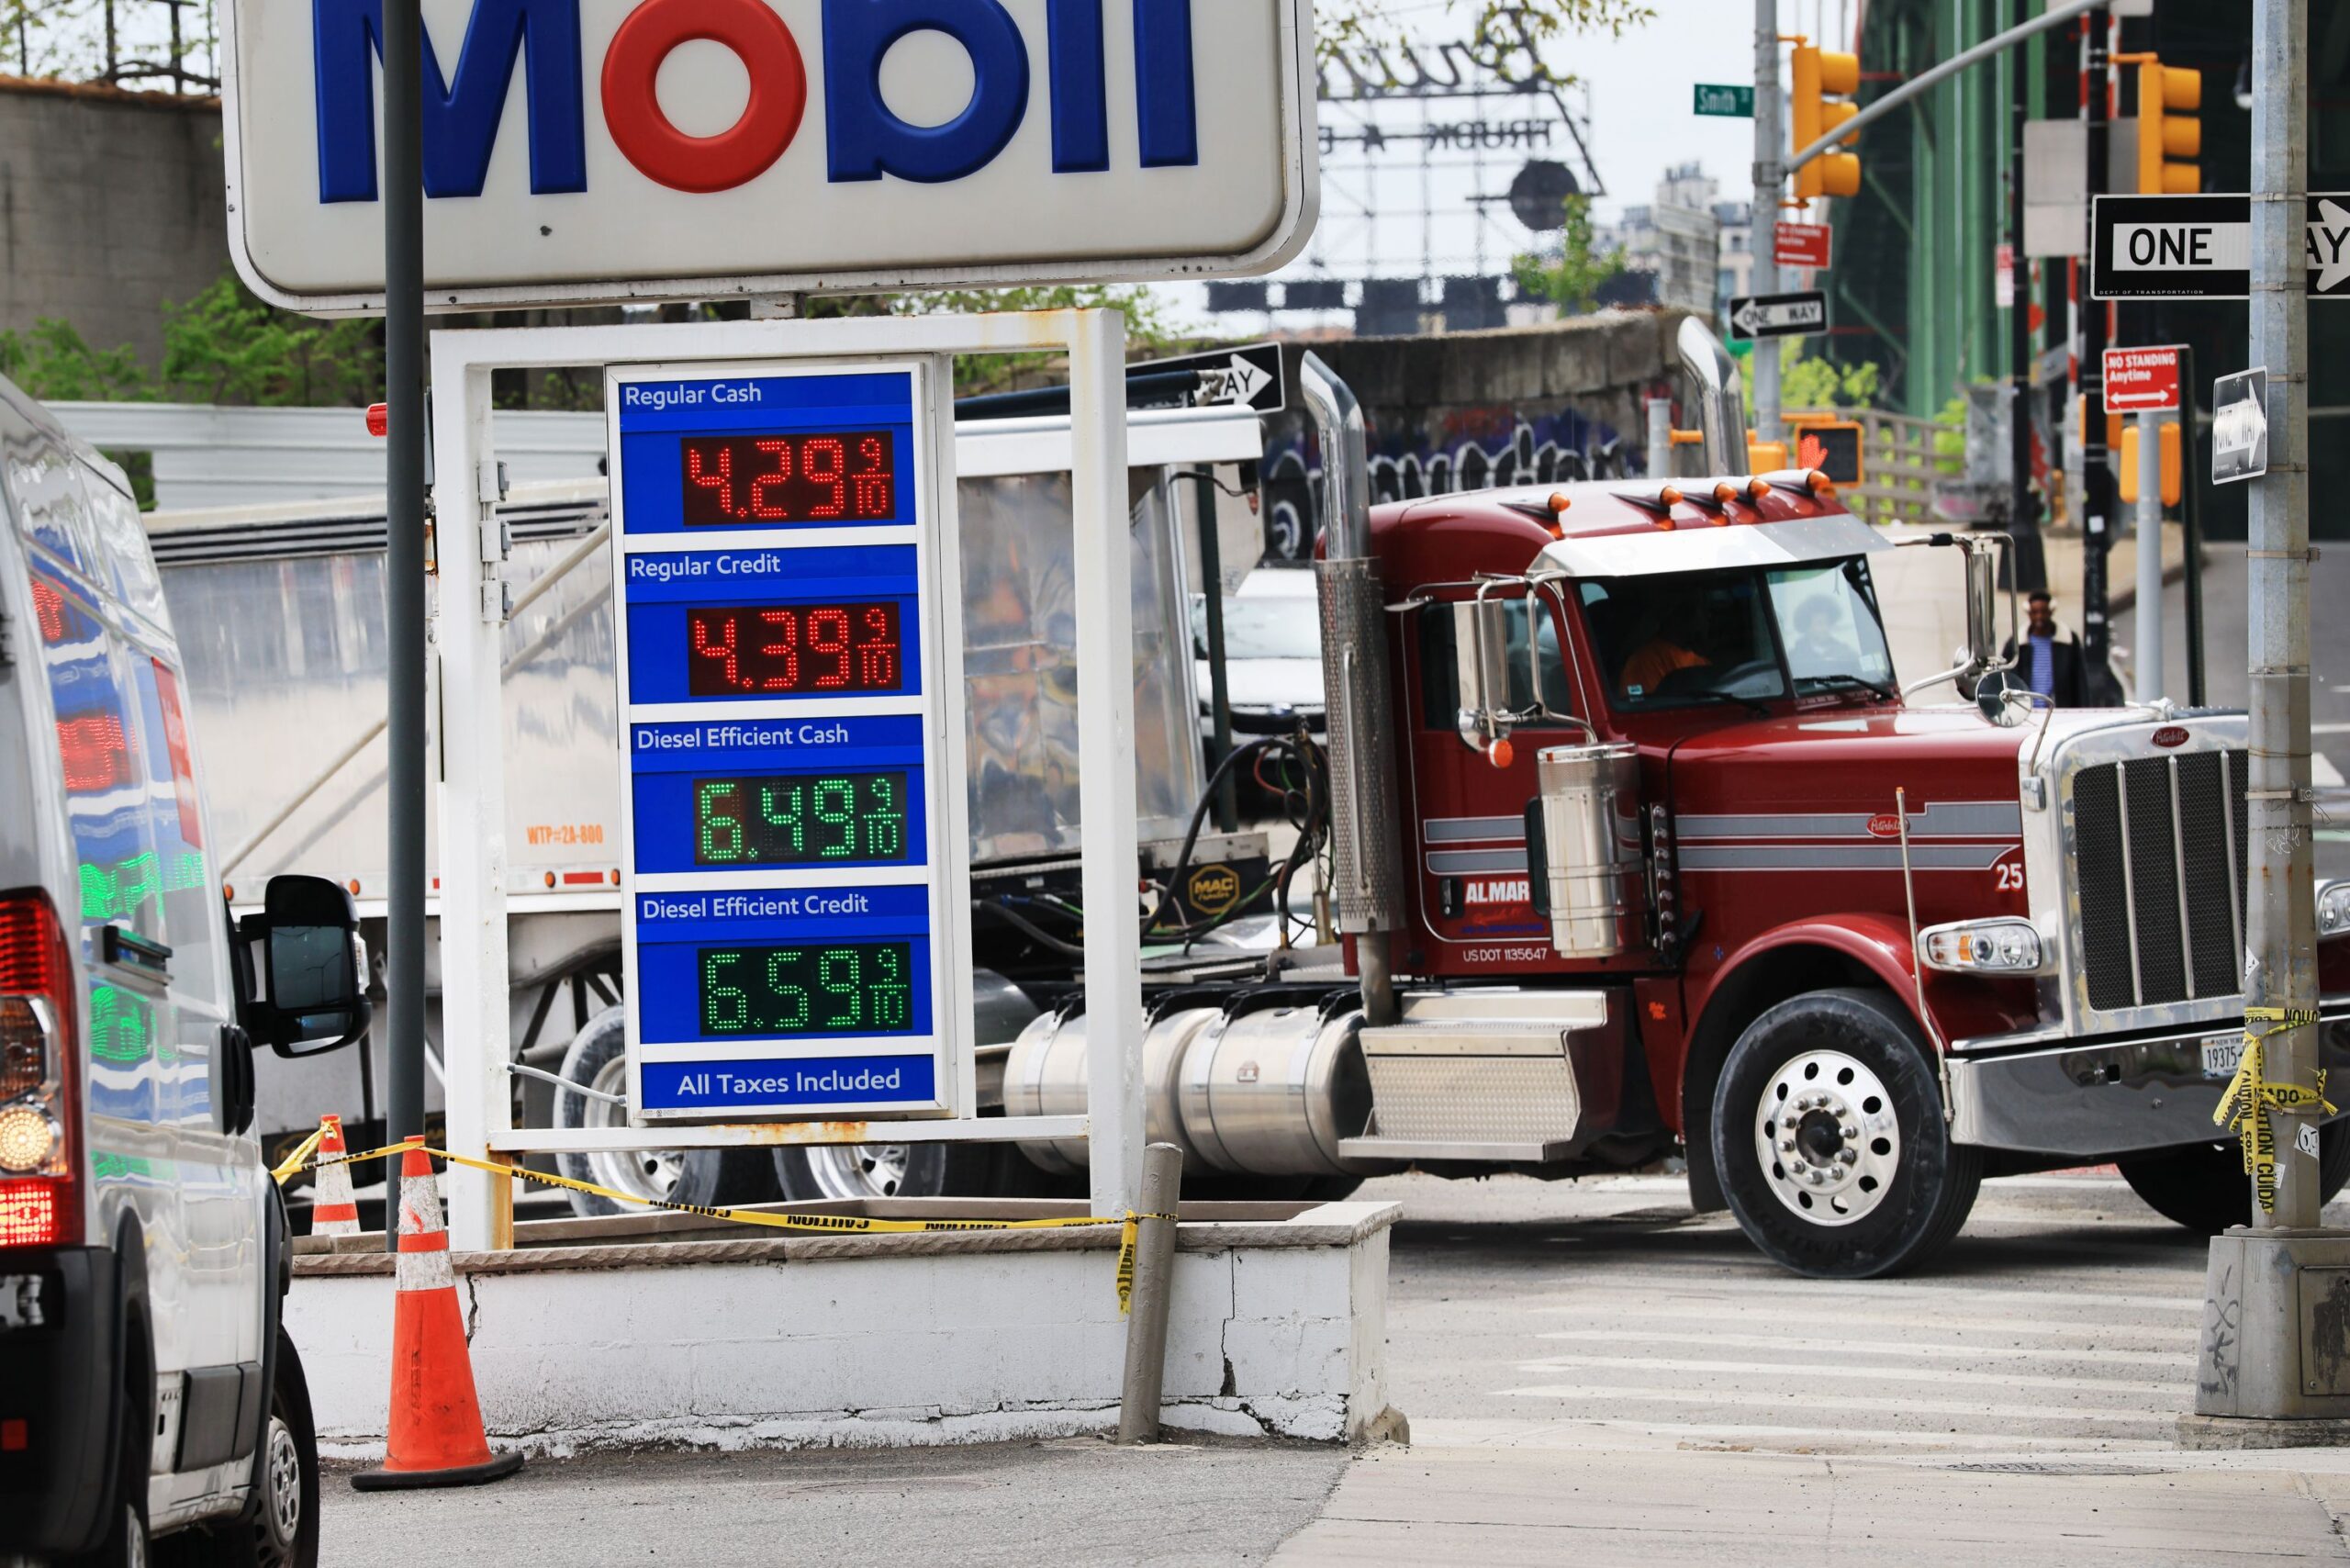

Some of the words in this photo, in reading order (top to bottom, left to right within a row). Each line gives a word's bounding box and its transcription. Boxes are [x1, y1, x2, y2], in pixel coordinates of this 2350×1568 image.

[1699, 86, 1737, 114] Smith
[2129, 228, 2213, 265] ONE
[2306, 227, 2350, 264] AY
[1744, 306, 1771, 325] ONE
[1789, 303, 1818, 321] WAY
[2108, 356, 2123, 368] NO
[2125, 353, 2177, 367] STANDING
[1218, 368, 1254, 398] AY
[2109, 369, 2152, 384] Anytime
[625, 385, 706, 410] Regular
[711, 383, 763, 404] Cash
[689, 438, 845, 518] 4.29
[630, 556, 711, 582] Regular
[716, 554, 781, 575] Credit
[695, 610, 850, 688] 4.39
[637, 728, 700, 749] Diesel
[707, 726, 793, 747] Efficient
[798, 723, 849, 745] Cash
[699, 778, 856, 860] 6.49
[1195, 877, 1235, 895] MAC
[1996, 863, 2024, 890] 25
[1466, 880, 1530, 903] ALMAR
[643, 898, 706, 920] Diesel
[712, 895, 800, 917] Efficient
[804, 894, 869, 915] Credit
[706, 949, 862, 1030] 6.59
[2208, 1047, 2237, 1069] 19375
[677, 1074, 711, 1096] All
[717, 1072, 789, 1094] Taxes
[796, 1069, 901, 1092] Included
[787, 1214, 870, 1230] CAUTION
